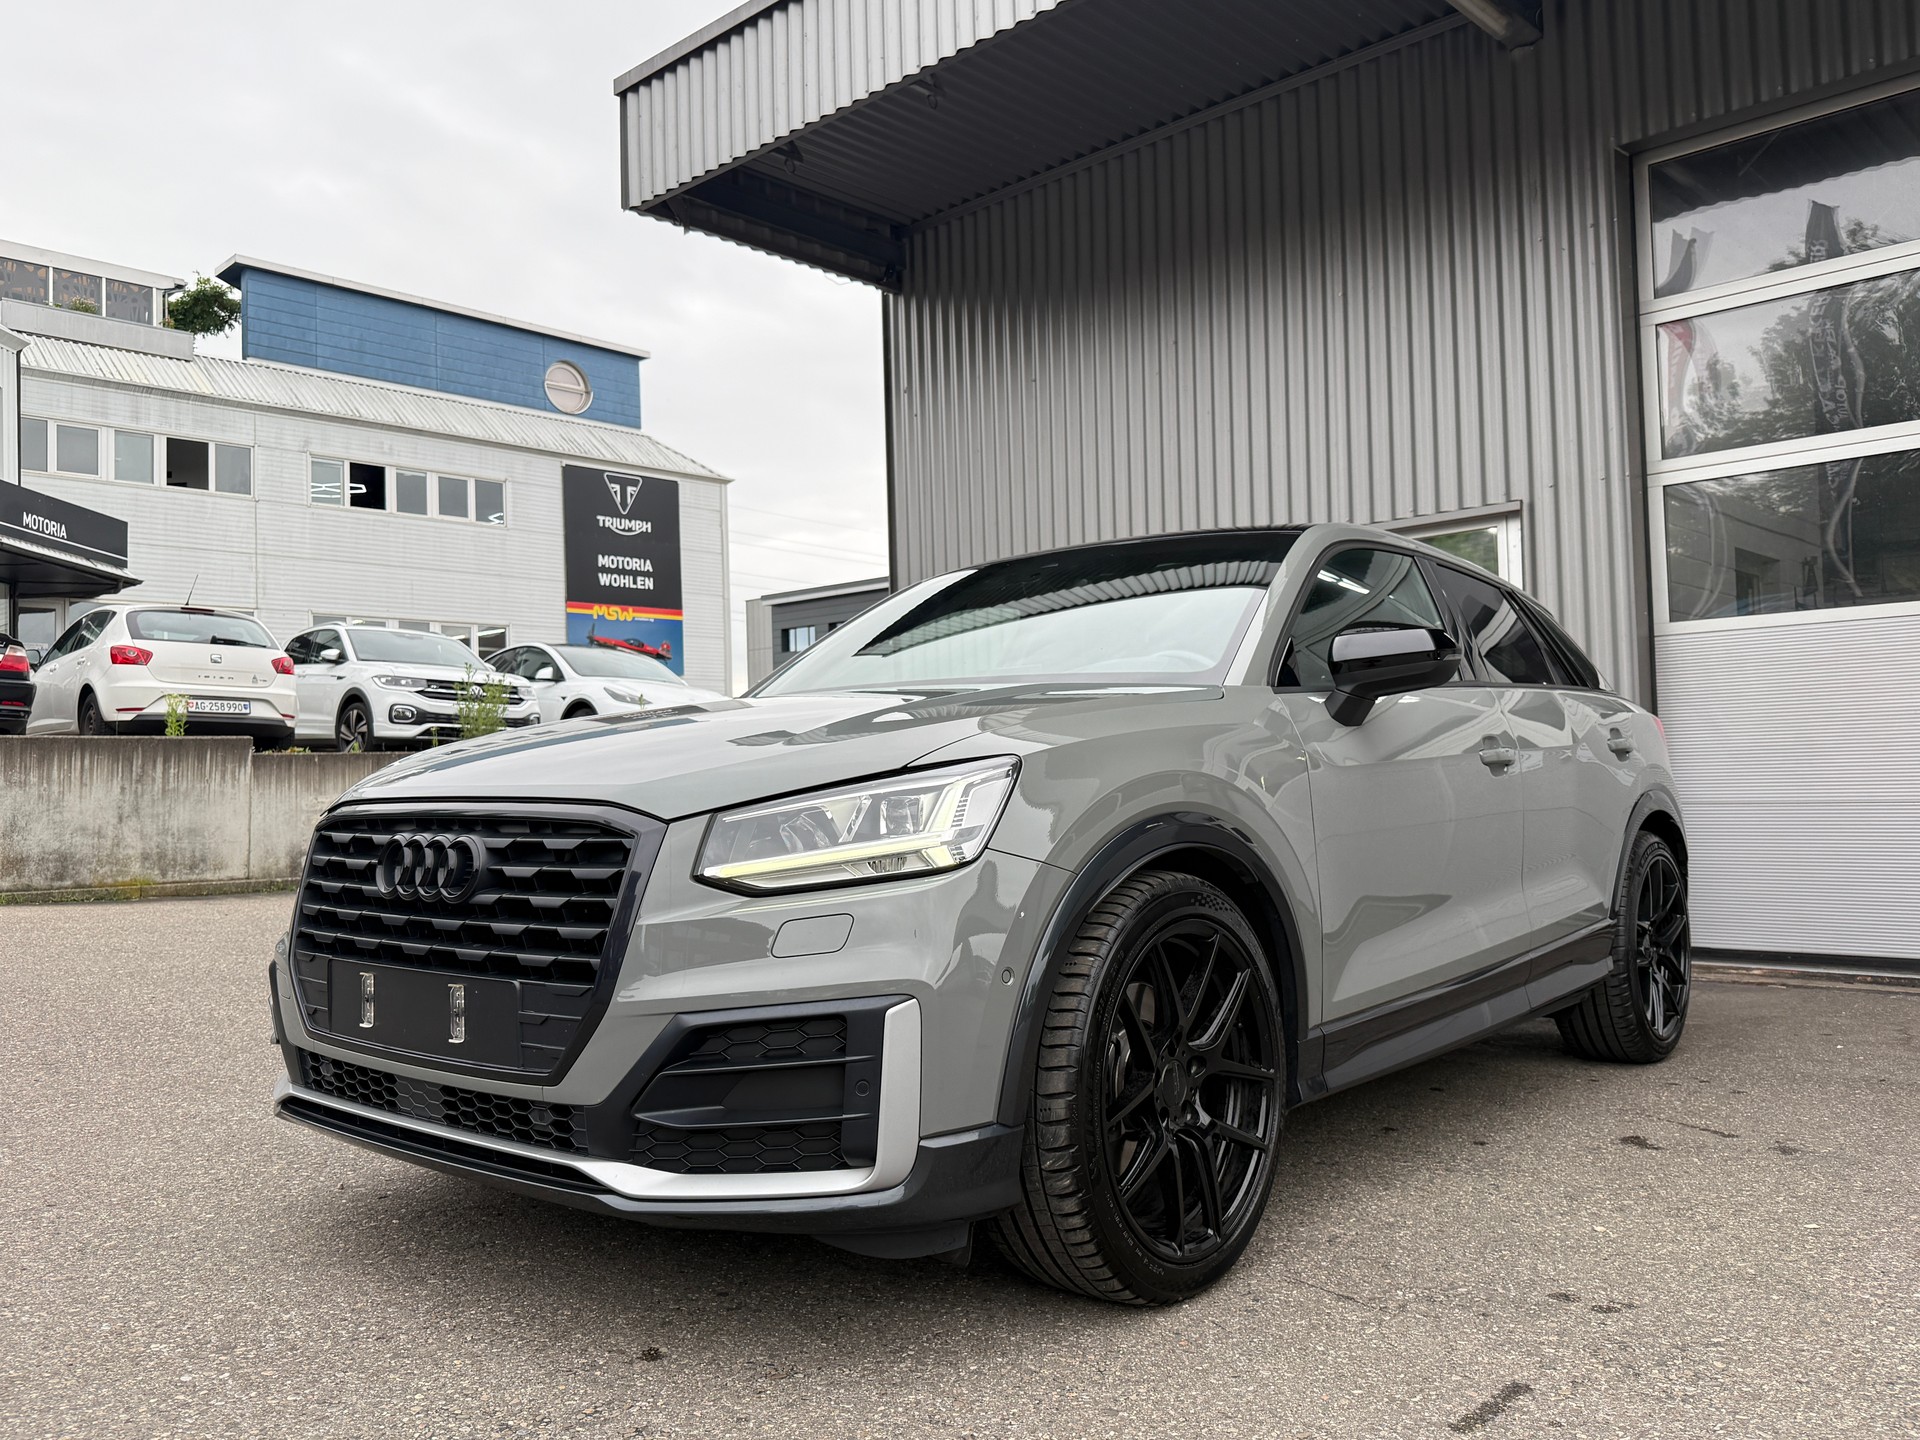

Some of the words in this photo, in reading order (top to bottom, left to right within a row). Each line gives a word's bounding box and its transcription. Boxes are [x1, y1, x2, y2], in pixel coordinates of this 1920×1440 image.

[22, 511, 67, 539] MOTORIA
[596, 515, 652, 534] TRIUMPH
[597, 554, 653, 572] MOTORIA
[597, 572, 654, 590] WOHLEN
[593, 605, 633, 621] MSW
